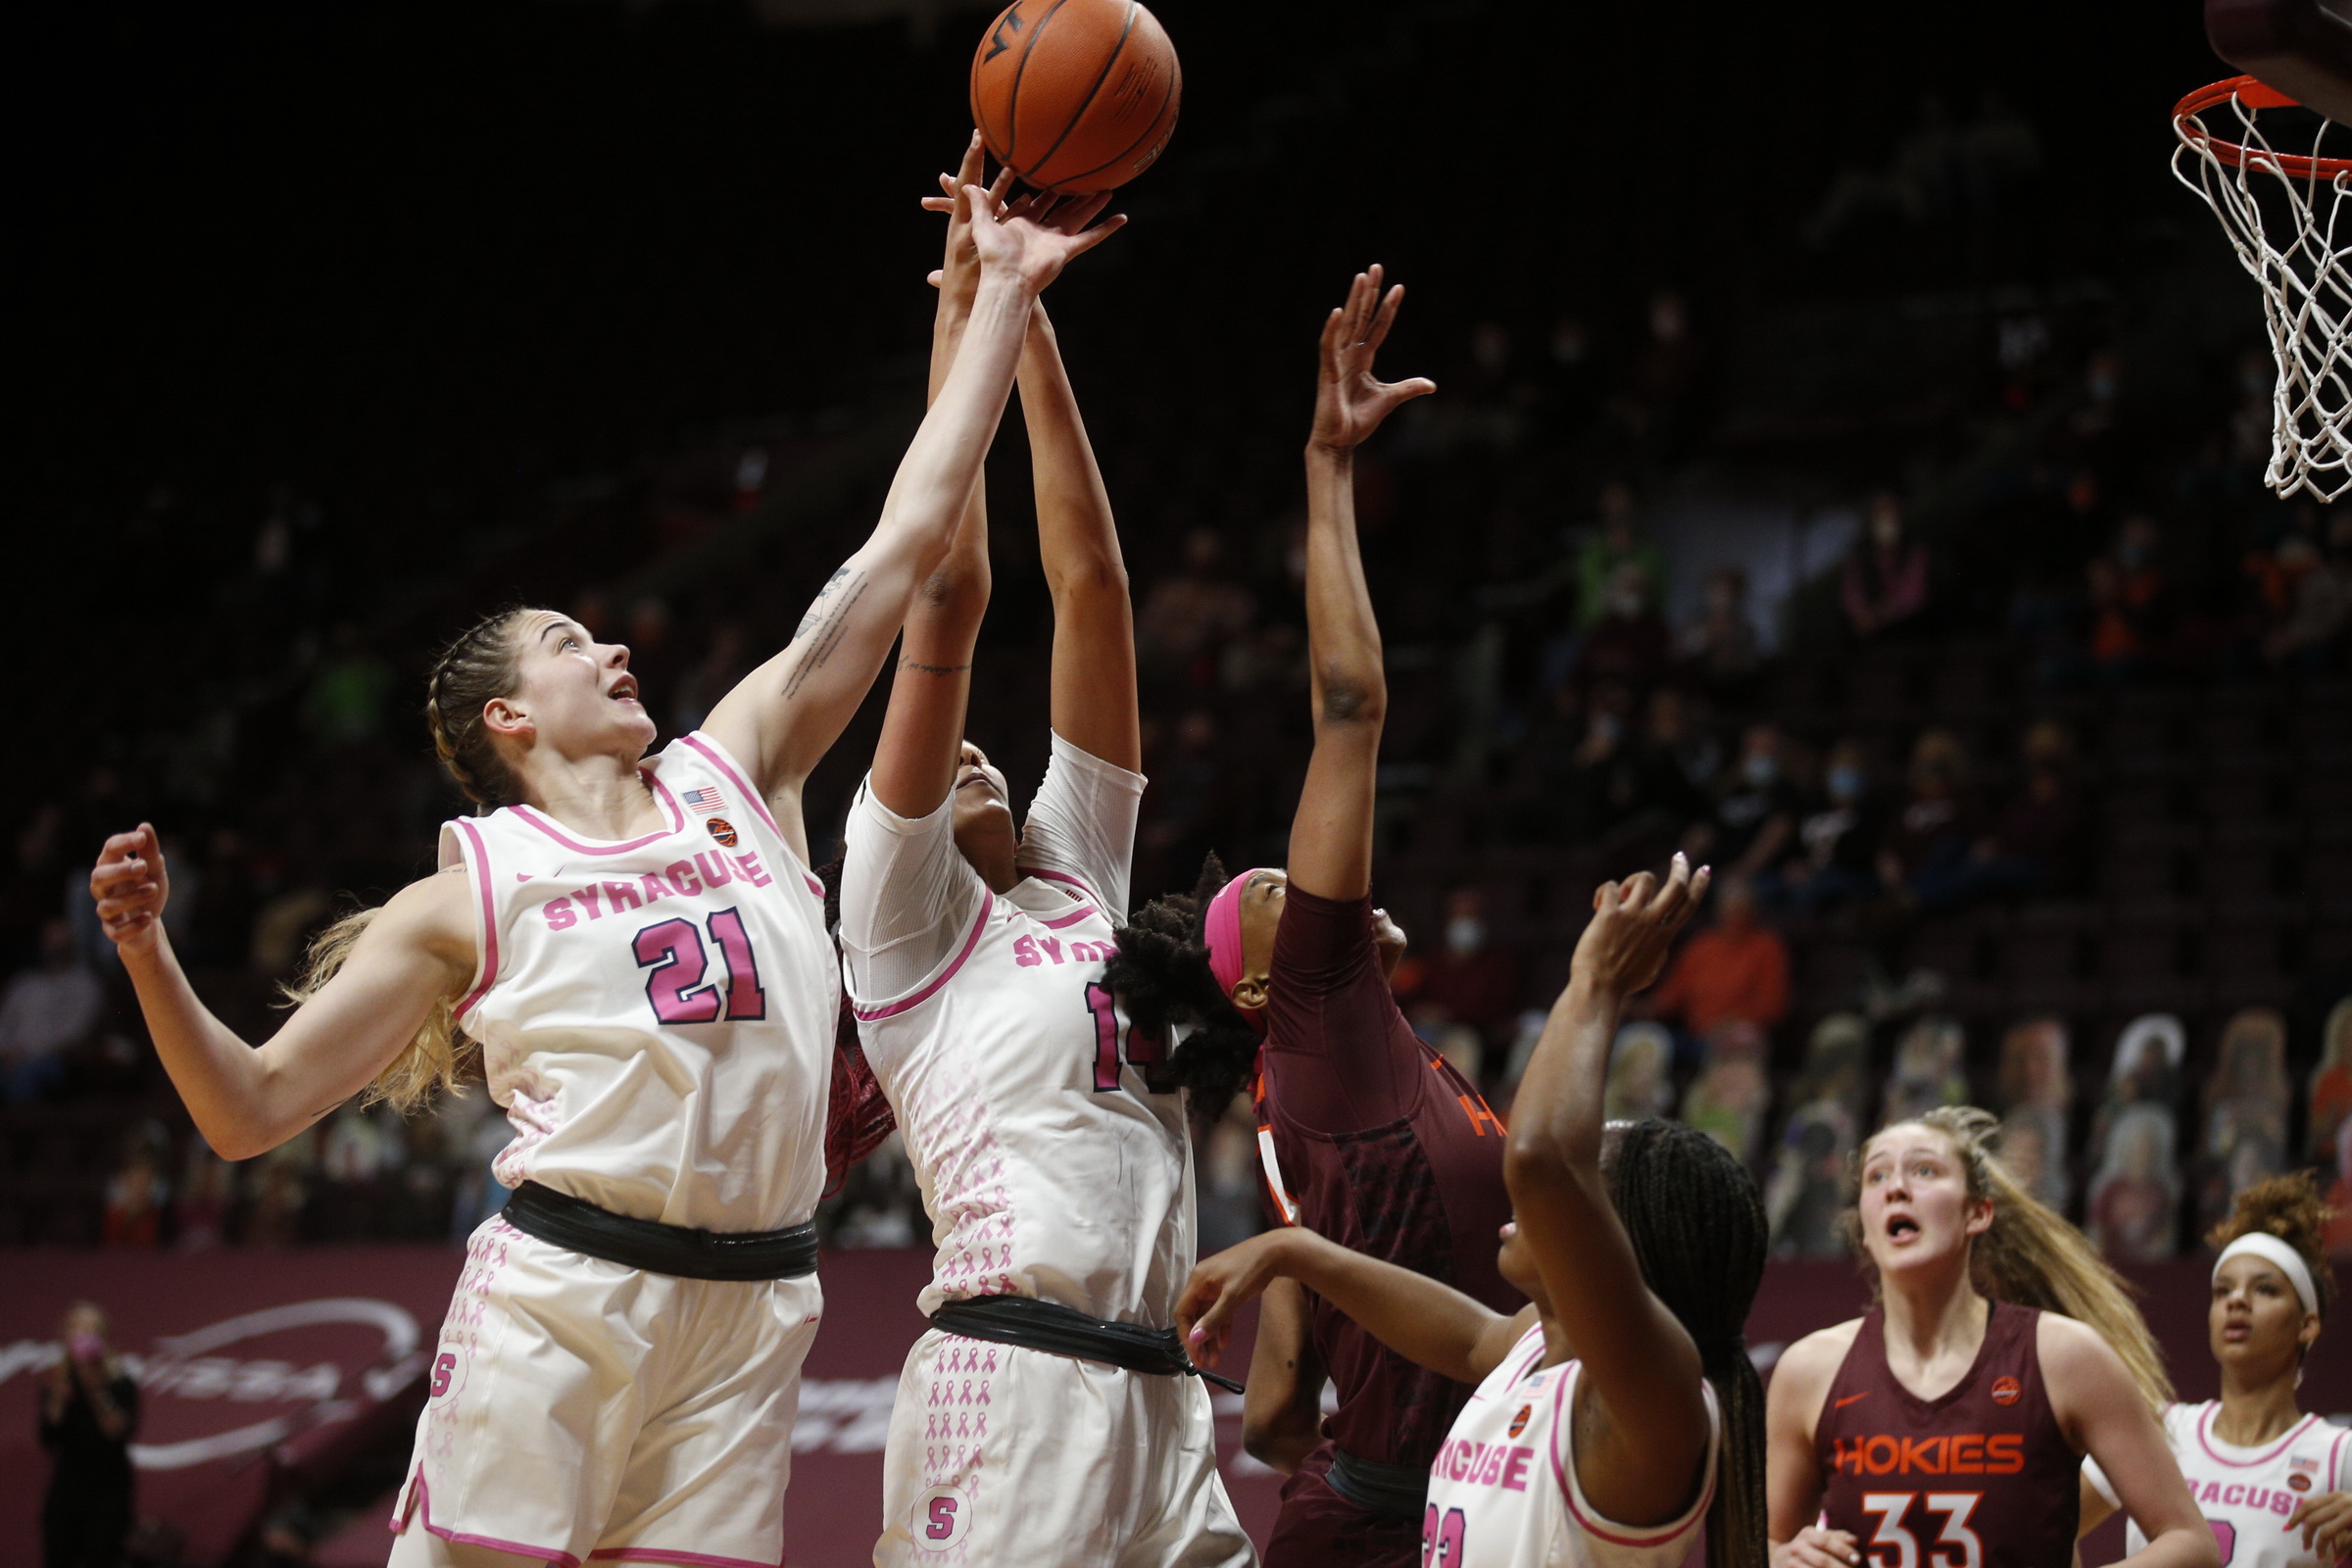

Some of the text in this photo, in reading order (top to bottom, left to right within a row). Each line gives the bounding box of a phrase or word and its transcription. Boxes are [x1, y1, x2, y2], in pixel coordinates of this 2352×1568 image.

[631, 906, 766, 1025] 21
[431, 1352, 457, 1397] S
[1833, 1434, 2026, 1475] HOKIES
[926, 1495, 958, 1540] S
[1861, 1491, 1984, 1568] 33
